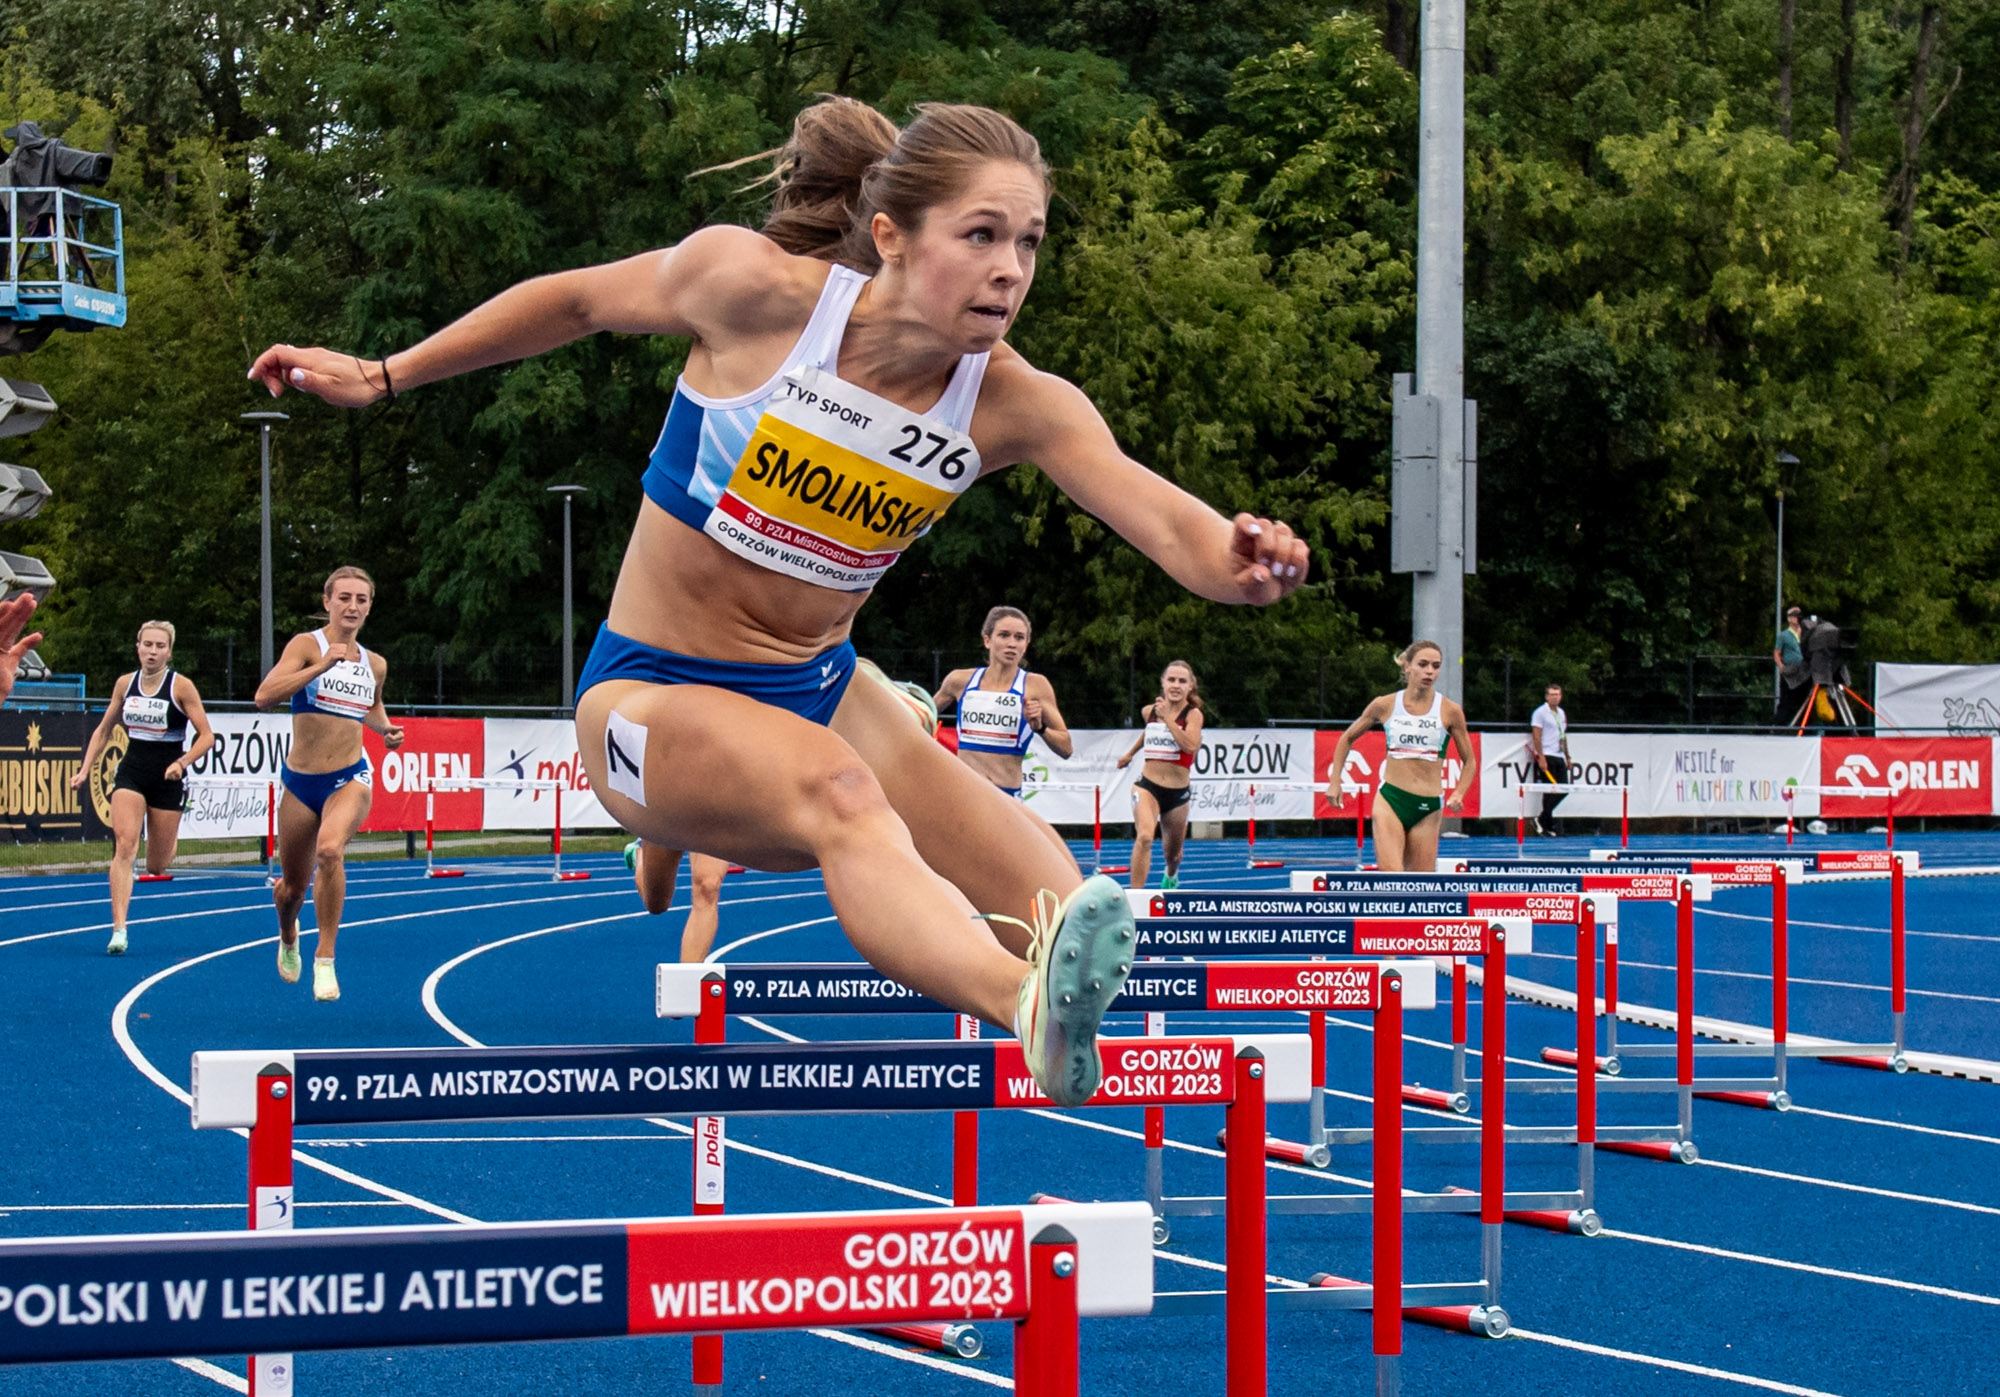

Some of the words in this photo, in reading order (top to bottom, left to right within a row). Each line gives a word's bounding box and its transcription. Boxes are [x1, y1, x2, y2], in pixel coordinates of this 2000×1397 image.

[787, 382, 817, 405] TVP
[819, 399, 872, 430] SPORT
[889, 424, 972, 480] 276
[747, 441, 936, 537] SMOLIŃSKA
[744, 512, 763, 531] 99.
[765, 523, 791, 541] PZLA
[793, 533, 860, 565] Mistrzostwa
[717, 520, 778, 557] GORZÓW
[780, 550, 863, 582] WIELKOPOLSKI
[148, 700, 164, 709] 148
[995, 696, 1016, 707] 465
[963, 711, 1018, 728] KORZUCH
[1418, 719, 1437, 728] 204
[191, 720, 291, 775] ORZÓW
[1399, 734, 1429, 745] GRYC
[607, 728, 640, 780] 7
[1195, 734, 1291, 774] ORZÓW
[1675, 748, 1717, 774] NESTLÉ
[1720, 755, 1735, 774] for
[360, 771, 370, 784] 5
[1498, 762, 1539, 788] TV
[1569, 762, 1633, 786] PORT
[1888, 760, 1979, 790] ORLEN
[1676, 778, 1744, 802] HEALTHIER
[1750, 779, 1778, 802] KIDS
[1735, 863, 1772, 873] GORZÓW
[1329, 881, 1345, 891] 99.
[1347, 881, 1371, 891] PZLA
[1374, 882, 1442, 892] MISTRZOSTWA
[1445, 883, 1478, 892] POLSKI
[1481, 883, 1491, 892] W
[1493, 883, 1529, 892] LEKKIEJ
[1532, 883, 1577, 892] ATLETYCE
[1631, 876, 1673, 887] GORZÓW
[1652, 888, 1673, 897] 2023
[1168, 902, 1185, 913] 99.
[1189, 901, 1217, 913] PZLA
[1221, 901, 1304, 913] MISTRZOSTWA
[1306, 902, 1346, 913] POLSKI
[1349, 902, 1361, 913] W
[1363, 902, 1405, 913] LEKKIEJ
[1408, 902, 1462, 913] ATLETYCE
[1526, 897, 1574, 909] GORZÓW
[1474, 908, 1547, 920] WIELKOPOLSKI
[1550, 909, 1574, 921] 2023
[1155, 931, 1204, 944] POLSKI
[1207, 931, 1221, 944] W
[1225, 930, 1276, 944] LEKKIEJ
[1280, 930, 1346, 943] ATLETYCE
[1424, 921, 1482, 937] GORZÓW
[1360, 938, 1450, 951] WIELKOPOLSKI
[1452, 939, 1482, 951] 2023
[1297, 967, 1371, 987] GORZÓW
[733, 980, 761, 998] 99.
[767, 980, 811, 998] PZLA
[816, 979, 922, 998] MISTRZOS
[1117, 979, 1197, 996] ATLETYCE
[1216, 987, 1329, 1005] WIELKOPOLSKI
[1333, 988, 1371, 1005] 2023
[1121, 1043, 1222, 1071] GORZÓW
[307, 1075, 347, 1101] 99.
[357, 1074, 420, 1099] PZLA
[430, 1068, 620, 1096] MISTRZOSTWA
[629, 1065, 718, 1091] POLSKI
[728, 1065, 752, 1088] W
[761, 1064, 853, 1088] LEKKIEJ
[862, 1064, 981, 1088] ATLETYCE
[1171, 1073, 1222, 1096] 2023
[844, 1221, 1014, 1269] GORZÓW
[163, 1279, 207, 1321] W
[222, 1273, 385, 1319] LEKKIEJ
[400, 1264, 604, 1311] ATLETYCE
[650, 1274, 919, 1319] WIELKOPOLSKI
[929, 1270, 1014, 1308] 2023
